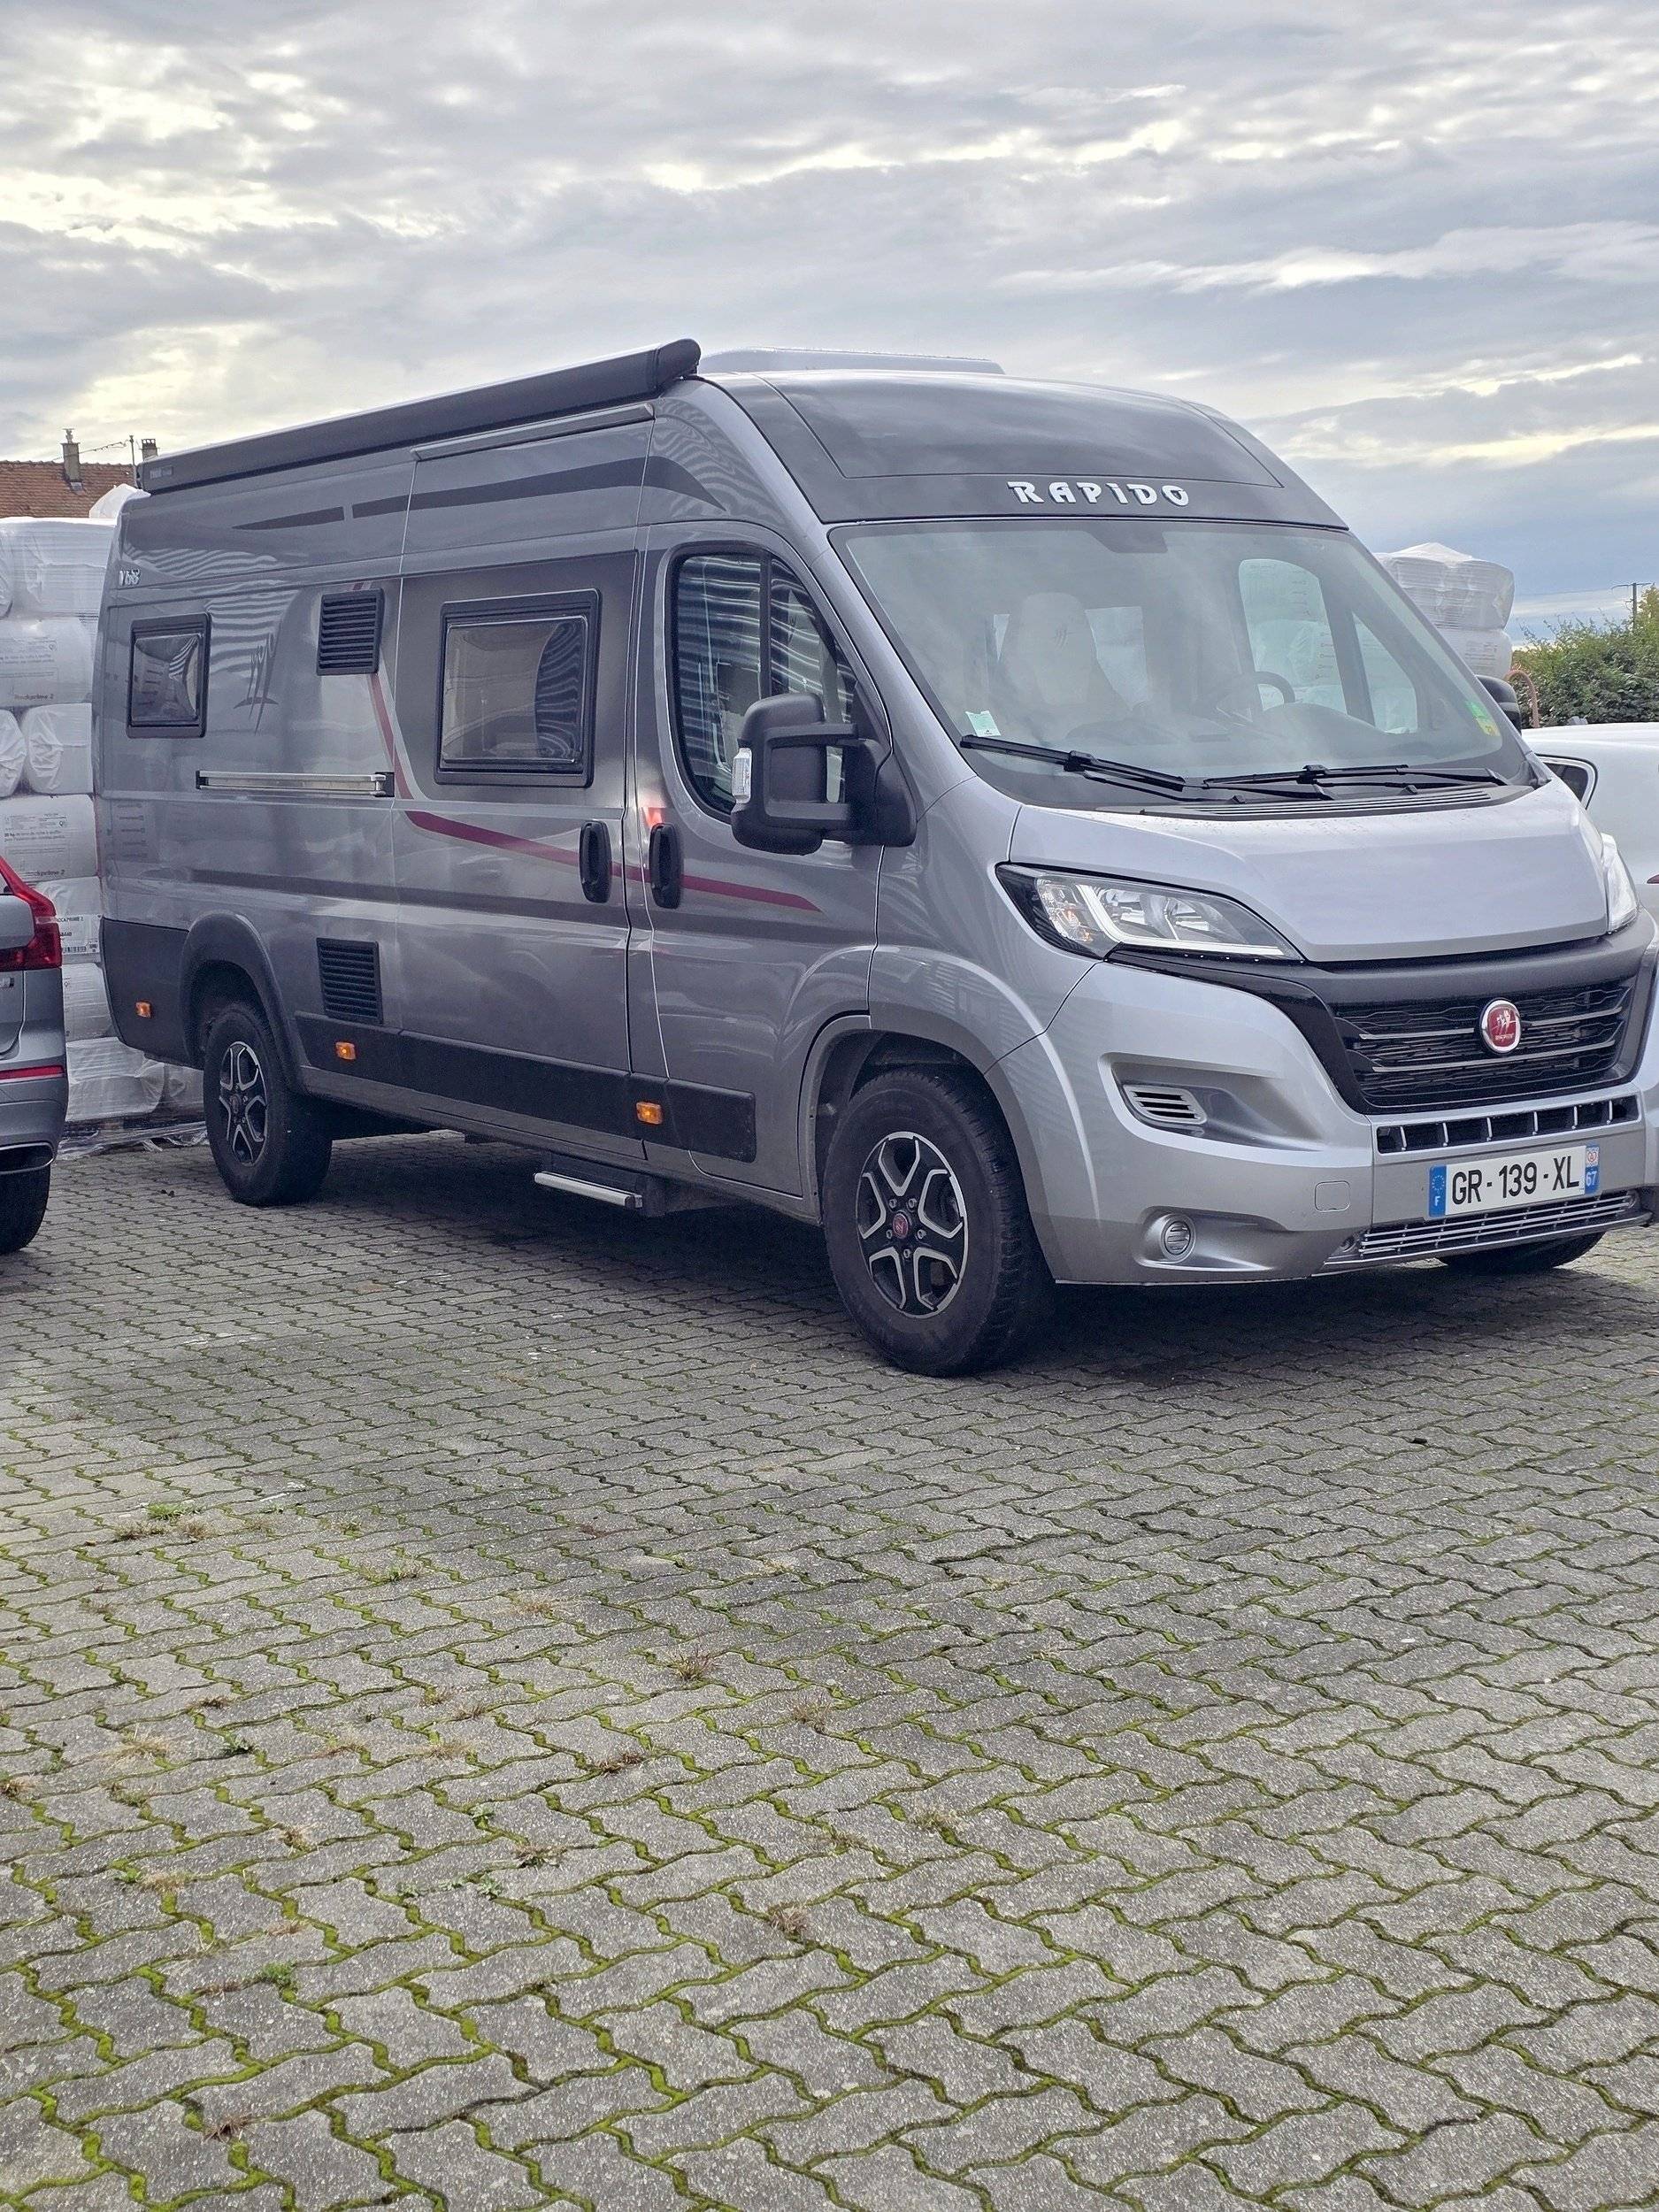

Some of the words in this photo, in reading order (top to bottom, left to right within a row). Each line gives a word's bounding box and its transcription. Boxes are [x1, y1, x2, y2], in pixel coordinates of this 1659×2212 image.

[1006, 481, 1189, 507] RAPIDO
[1586, 1171, 1598, 1187] 67
[1434, 1195, 1441, 1207] F
